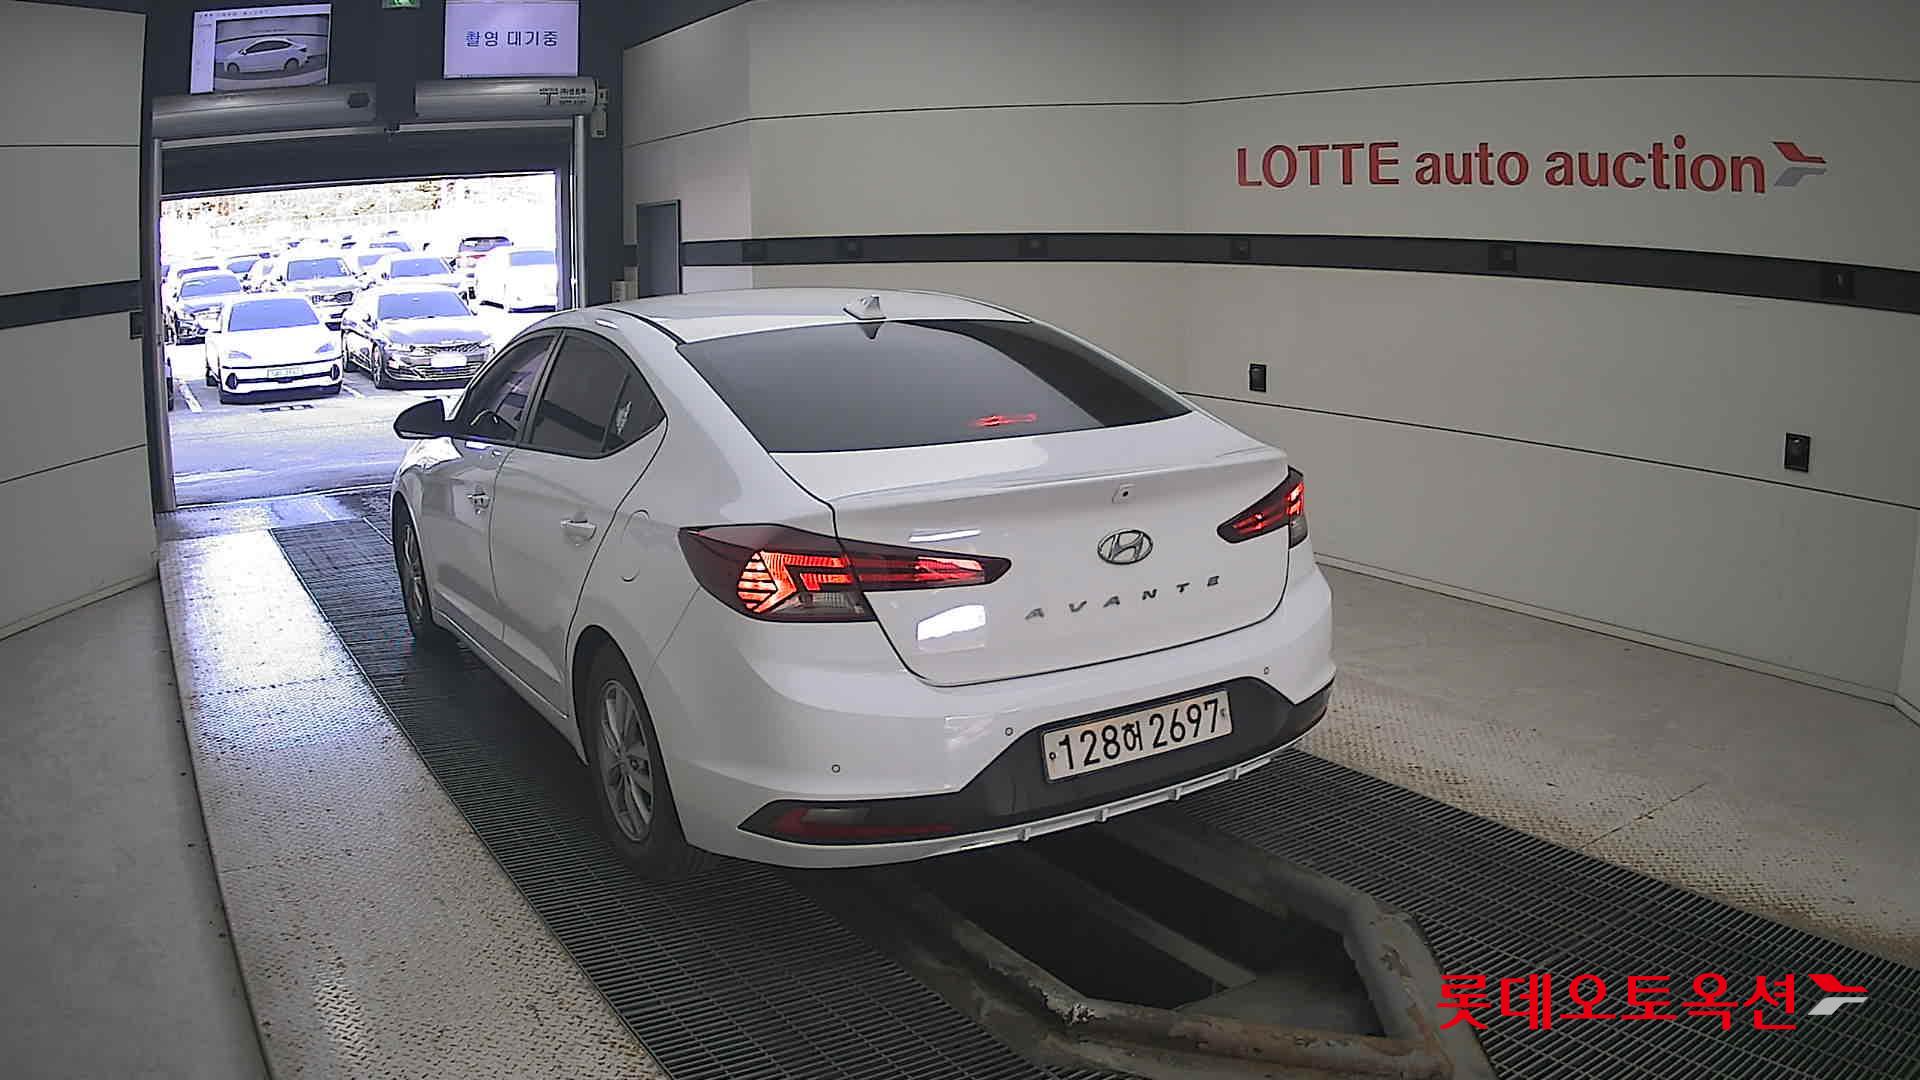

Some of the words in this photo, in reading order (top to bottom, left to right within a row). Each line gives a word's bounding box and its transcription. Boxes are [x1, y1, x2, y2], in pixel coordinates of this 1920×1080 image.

[465, 30, 499, 47] 촬영
[507, 30, 559, 47] 대기중
[1236, 141, 1399, 188] LOTTE
[1415, 142, 1529, 186] auto
[1545, 134, 1766, 194] auction
[1024, 575, 1221, 620] AVANTE
[1058, 720, 1144, 770] 128허
[1149, 699, 1220, 749] 2697
